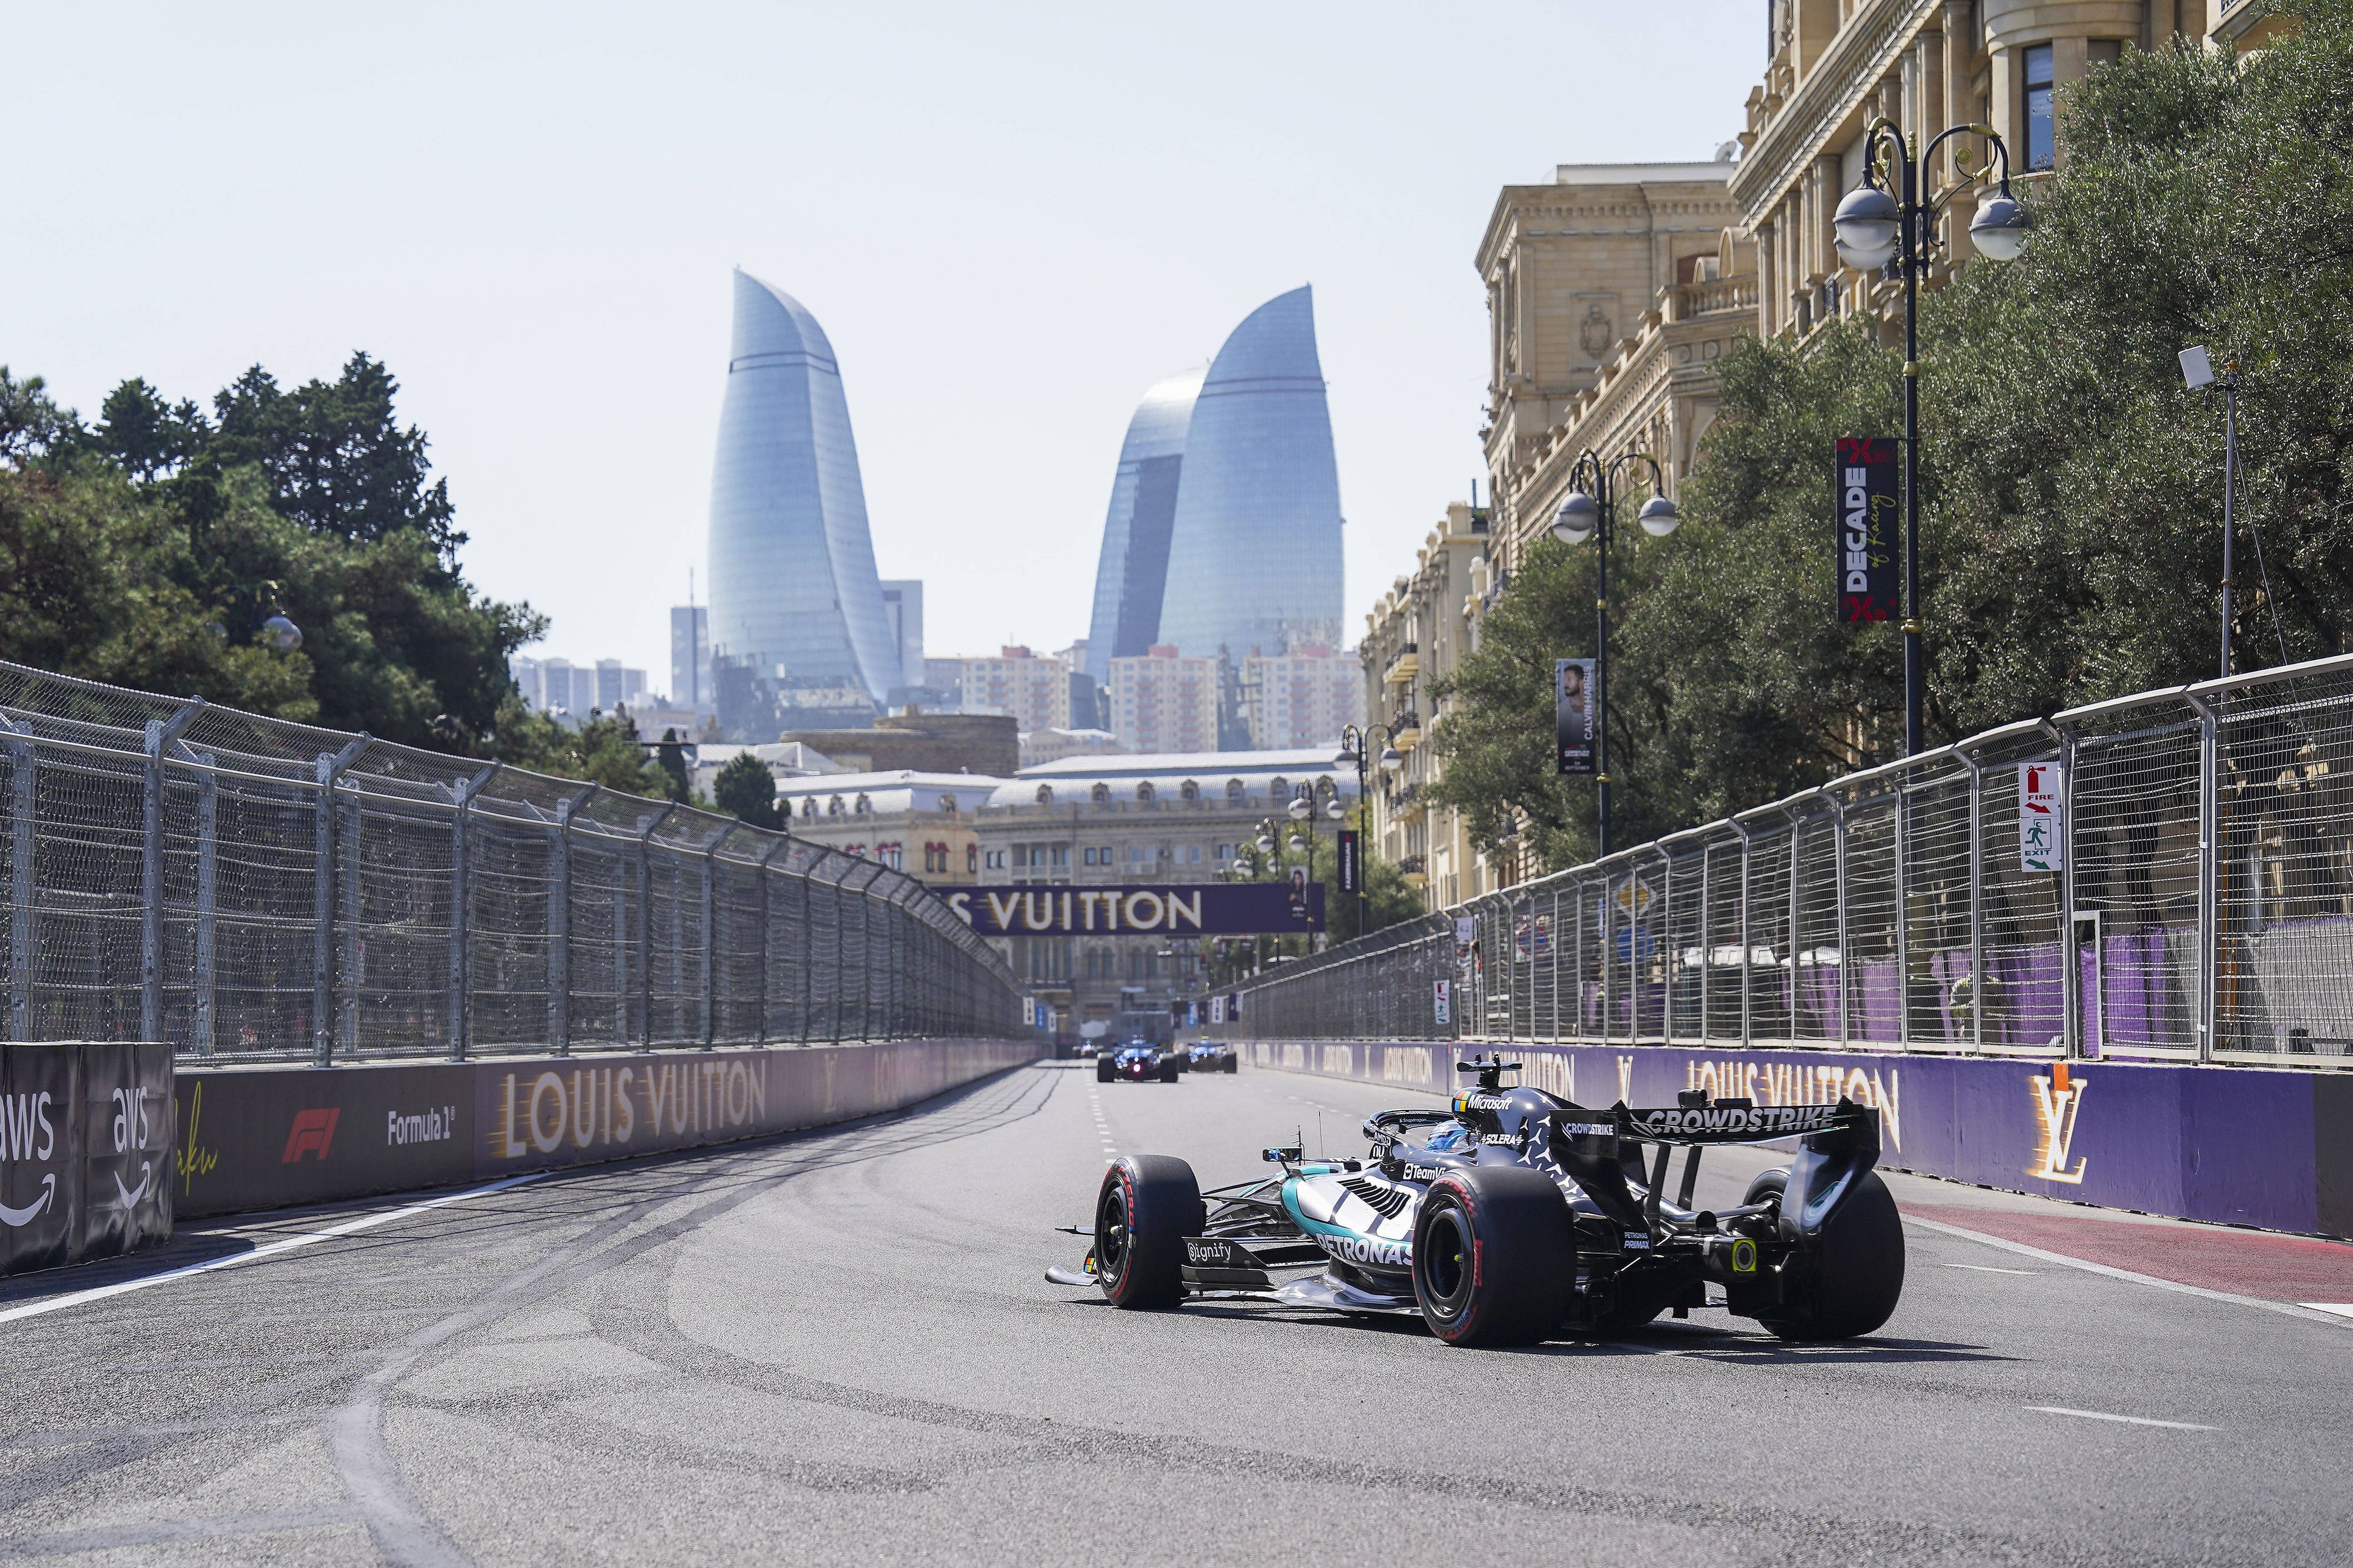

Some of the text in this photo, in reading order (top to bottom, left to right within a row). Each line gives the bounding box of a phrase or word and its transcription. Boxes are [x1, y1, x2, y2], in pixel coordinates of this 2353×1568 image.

[1845, 467, 1867, 592] DECADE
[1584, 705, 1593, 740] CALVIN
[987, 890, 1201, 930] VUITTON
[113, 1086, 148, 1153] aws
[506, 1059, 765, 1158] LOUIS VUITTON
[1468, 1095, 1514, 1110] Microsoft
[1647, 1106, 1837, 1134] CROWDSTRIKE
[0, 1091, 54, 1162] ws
[388, 1110, 441, 1145] Formula
[1485, 1133, 1516, 1145] SOLERA
[1566, 1123, 1614, 1136] CROWDSTRIKE
[1316, 1233, 1412, 1266] PETRONAS
[1624, 1240, 1650, 1249] PRIMAX
